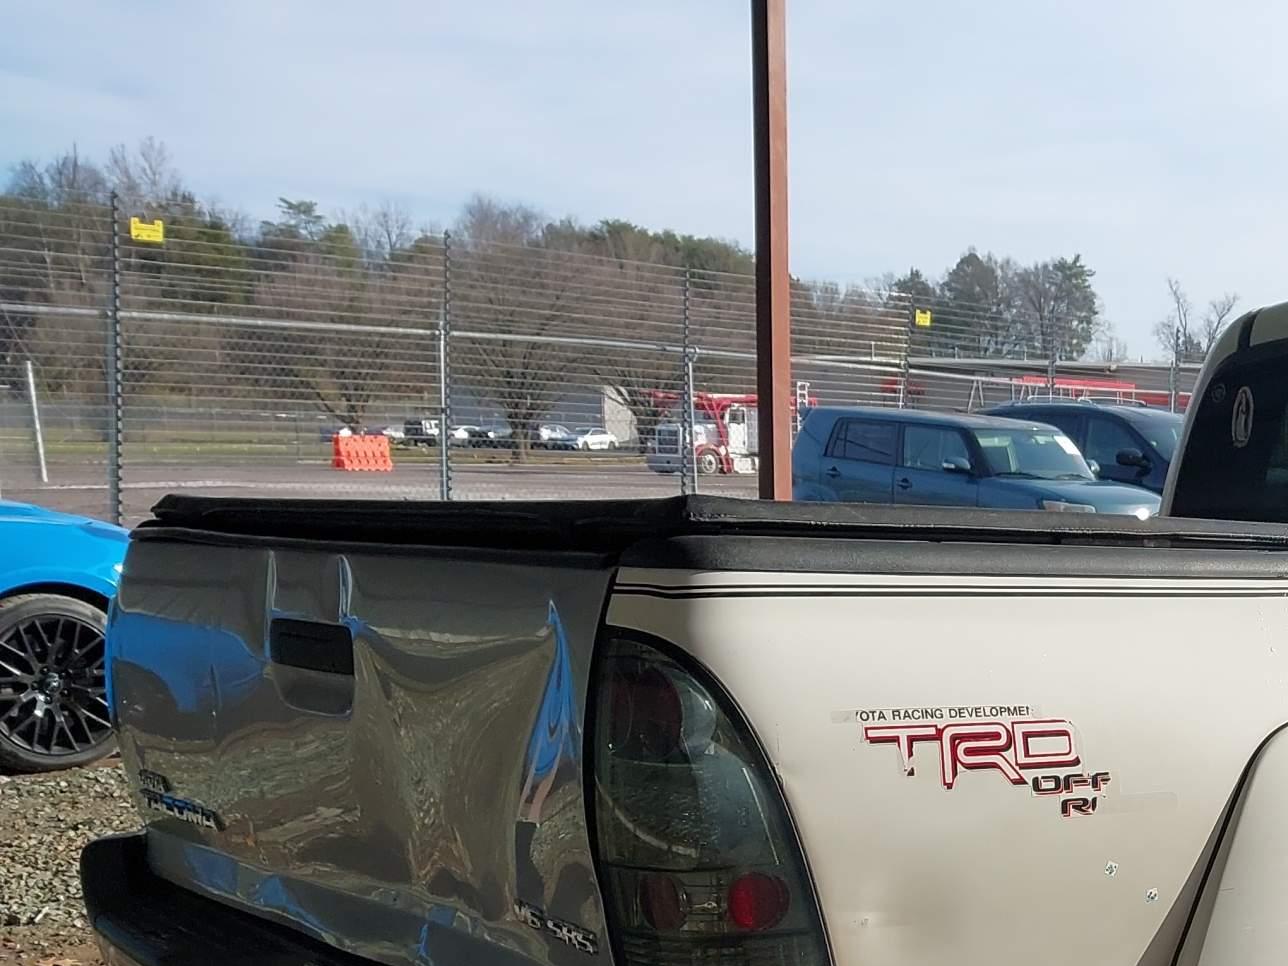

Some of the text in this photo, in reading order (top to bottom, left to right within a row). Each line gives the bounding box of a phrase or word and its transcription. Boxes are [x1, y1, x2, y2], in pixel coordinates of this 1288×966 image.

[892, 708, 944, 720] RACING
[863, 720, 1081, 789] TRD
[1032, 772, 1111, 795] OFF
